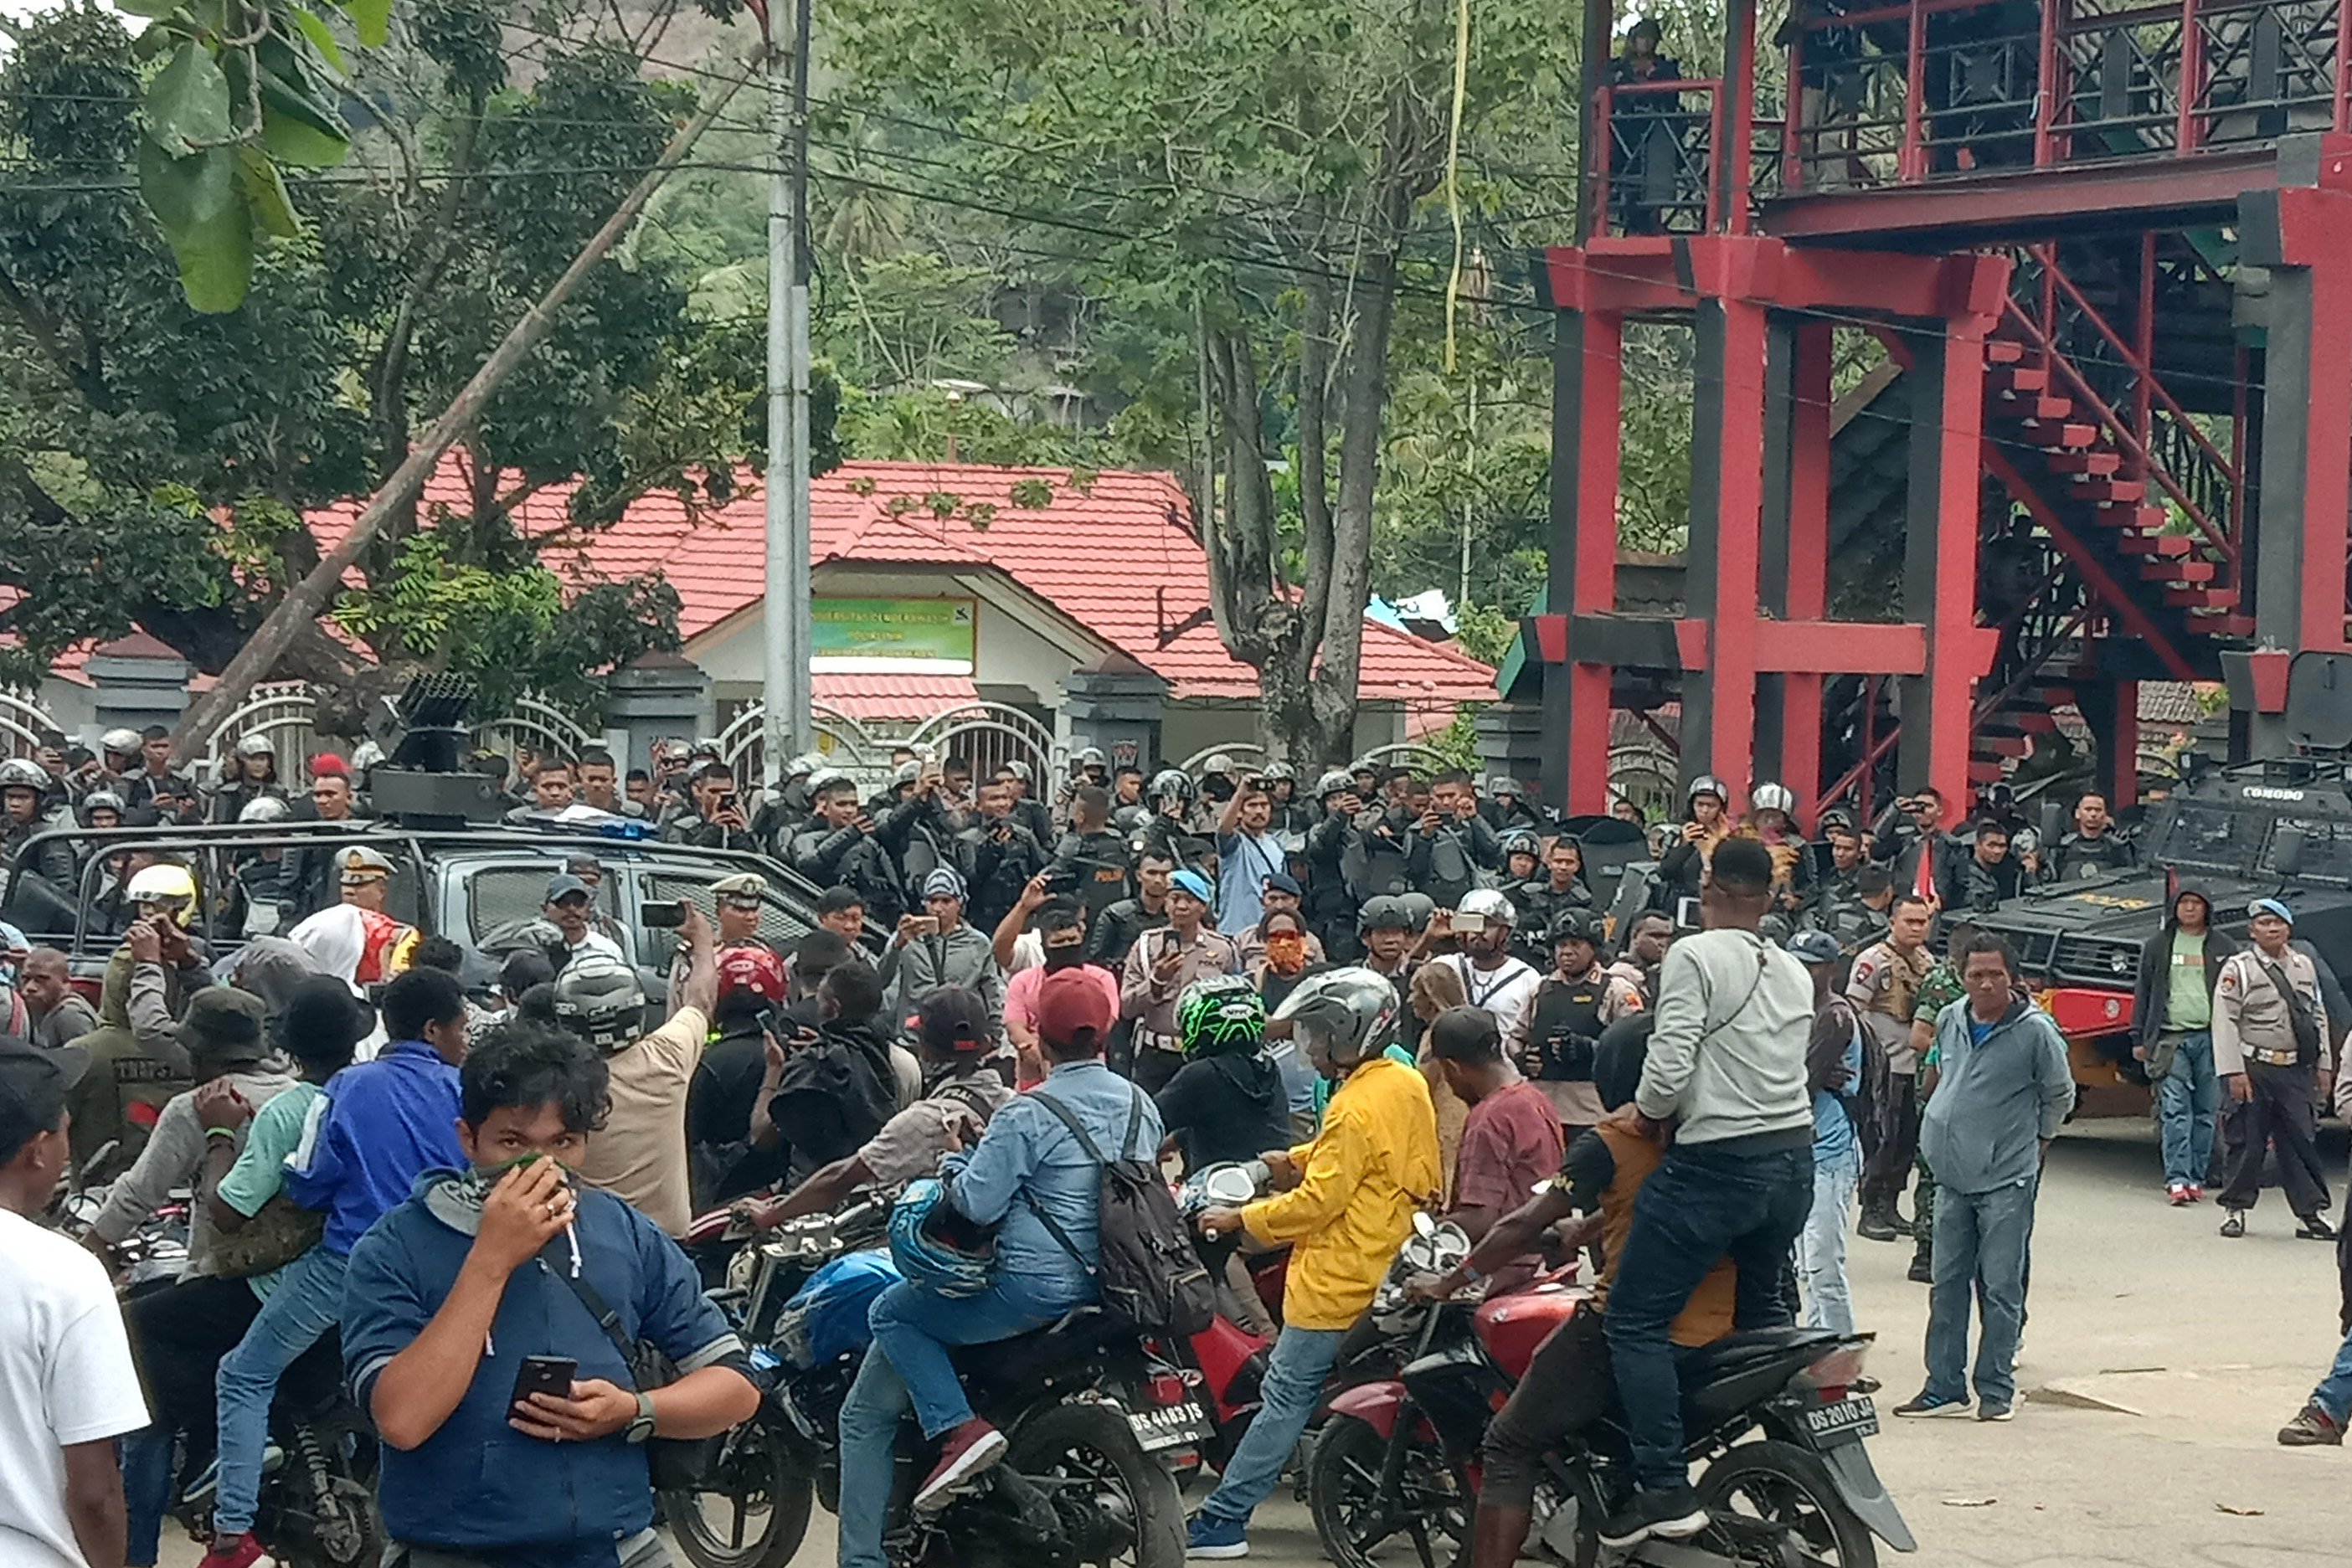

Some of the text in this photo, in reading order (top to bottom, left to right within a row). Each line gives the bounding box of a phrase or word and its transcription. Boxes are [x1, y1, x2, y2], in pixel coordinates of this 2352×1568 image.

[2242, 786, 2304, 801] COMODO
[1130, 1412, 1151, 1432] DS
[1807, 1410, 1829, 1431] DS
[1825, 1401, 1859, 1426] 2010
